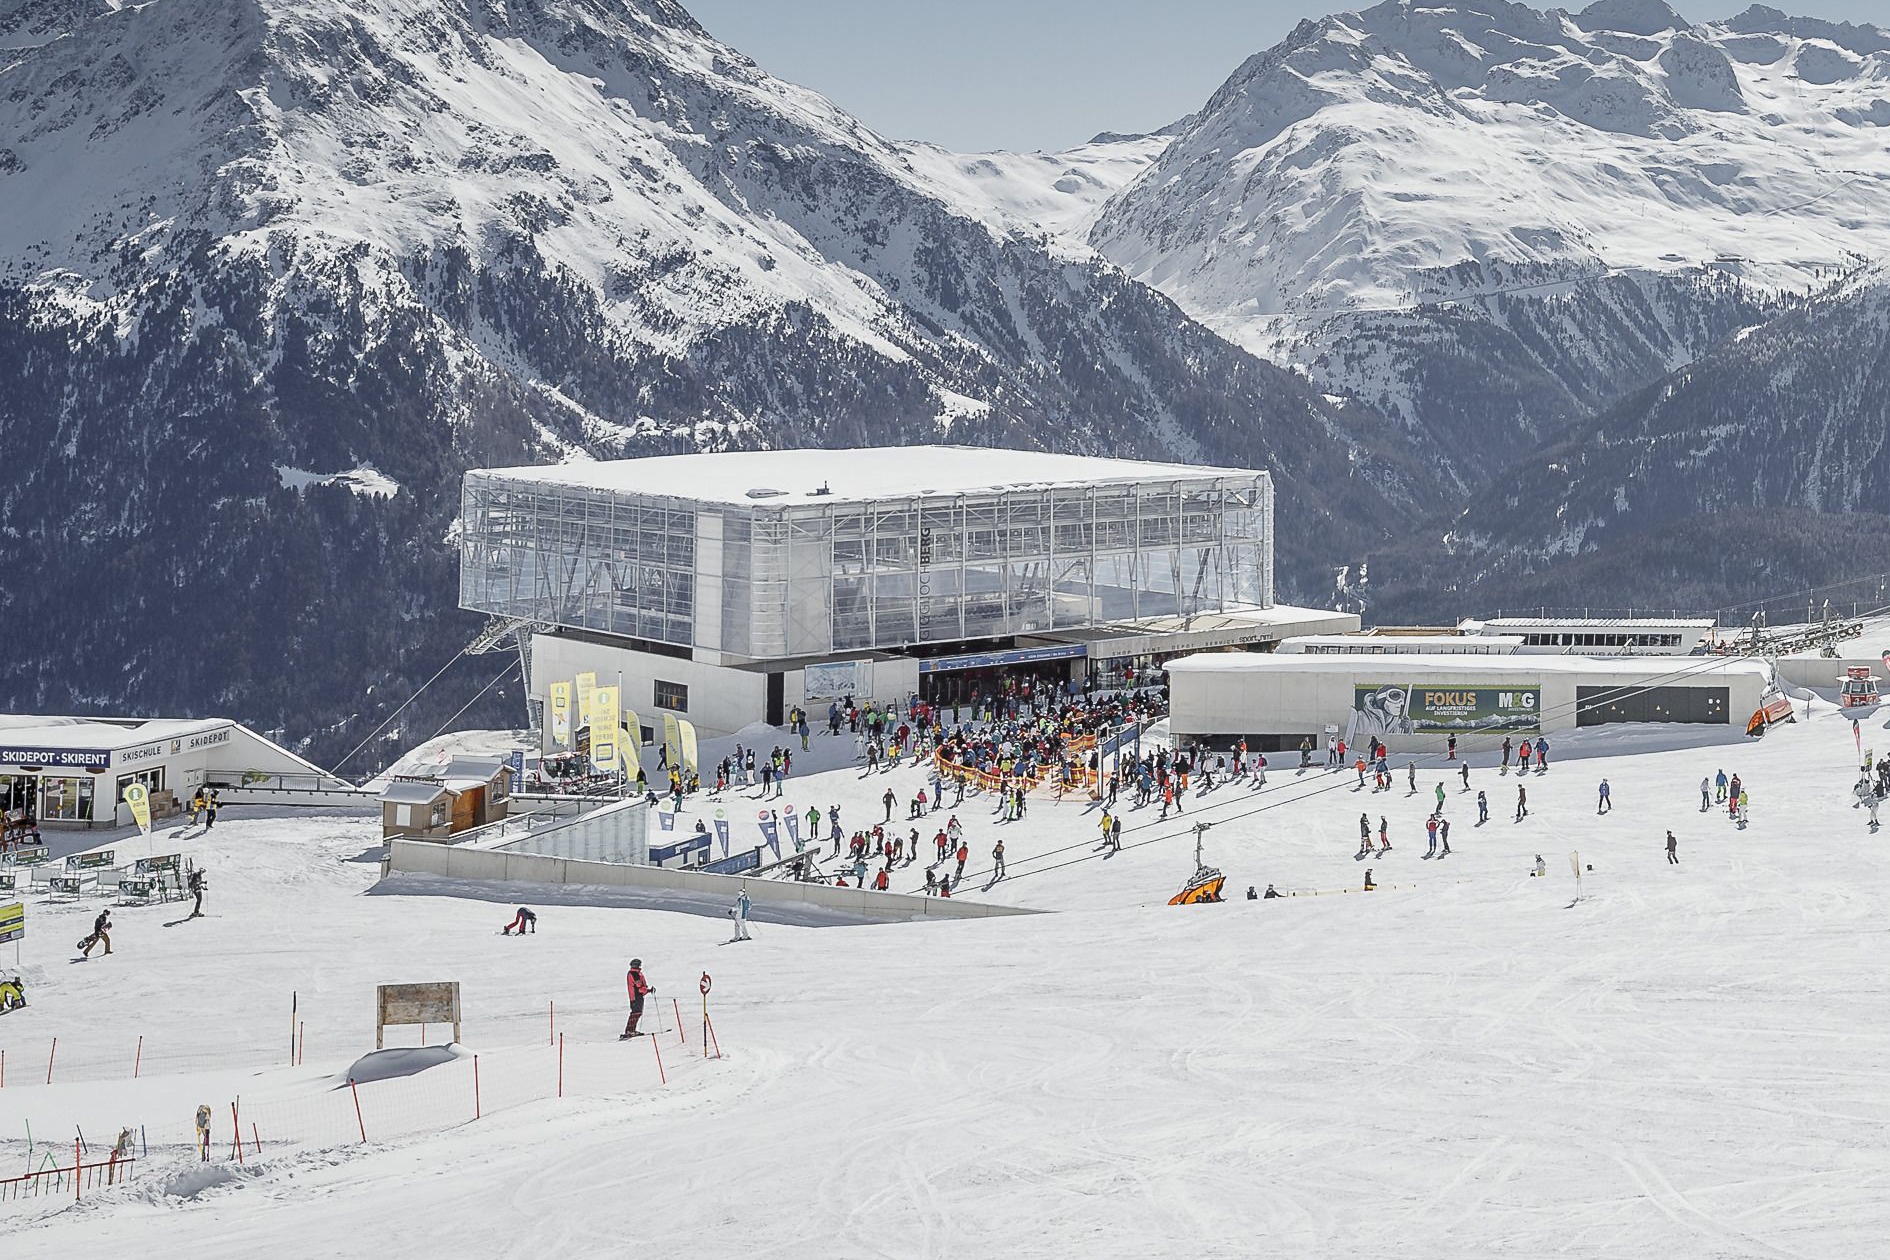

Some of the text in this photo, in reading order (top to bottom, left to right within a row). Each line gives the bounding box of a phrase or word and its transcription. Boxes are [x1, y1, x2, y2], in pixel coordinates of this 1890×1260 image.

[1425, 692, 1477, 706] FOKUS
[1498, 692, 1535, 708] M&G
[190, 731, 227, 747] SKIDEPOT
[2, 750, 107, 765] SKIDEPOT SKIRENT
[122, 745, 162, 762] SKISCHULE
